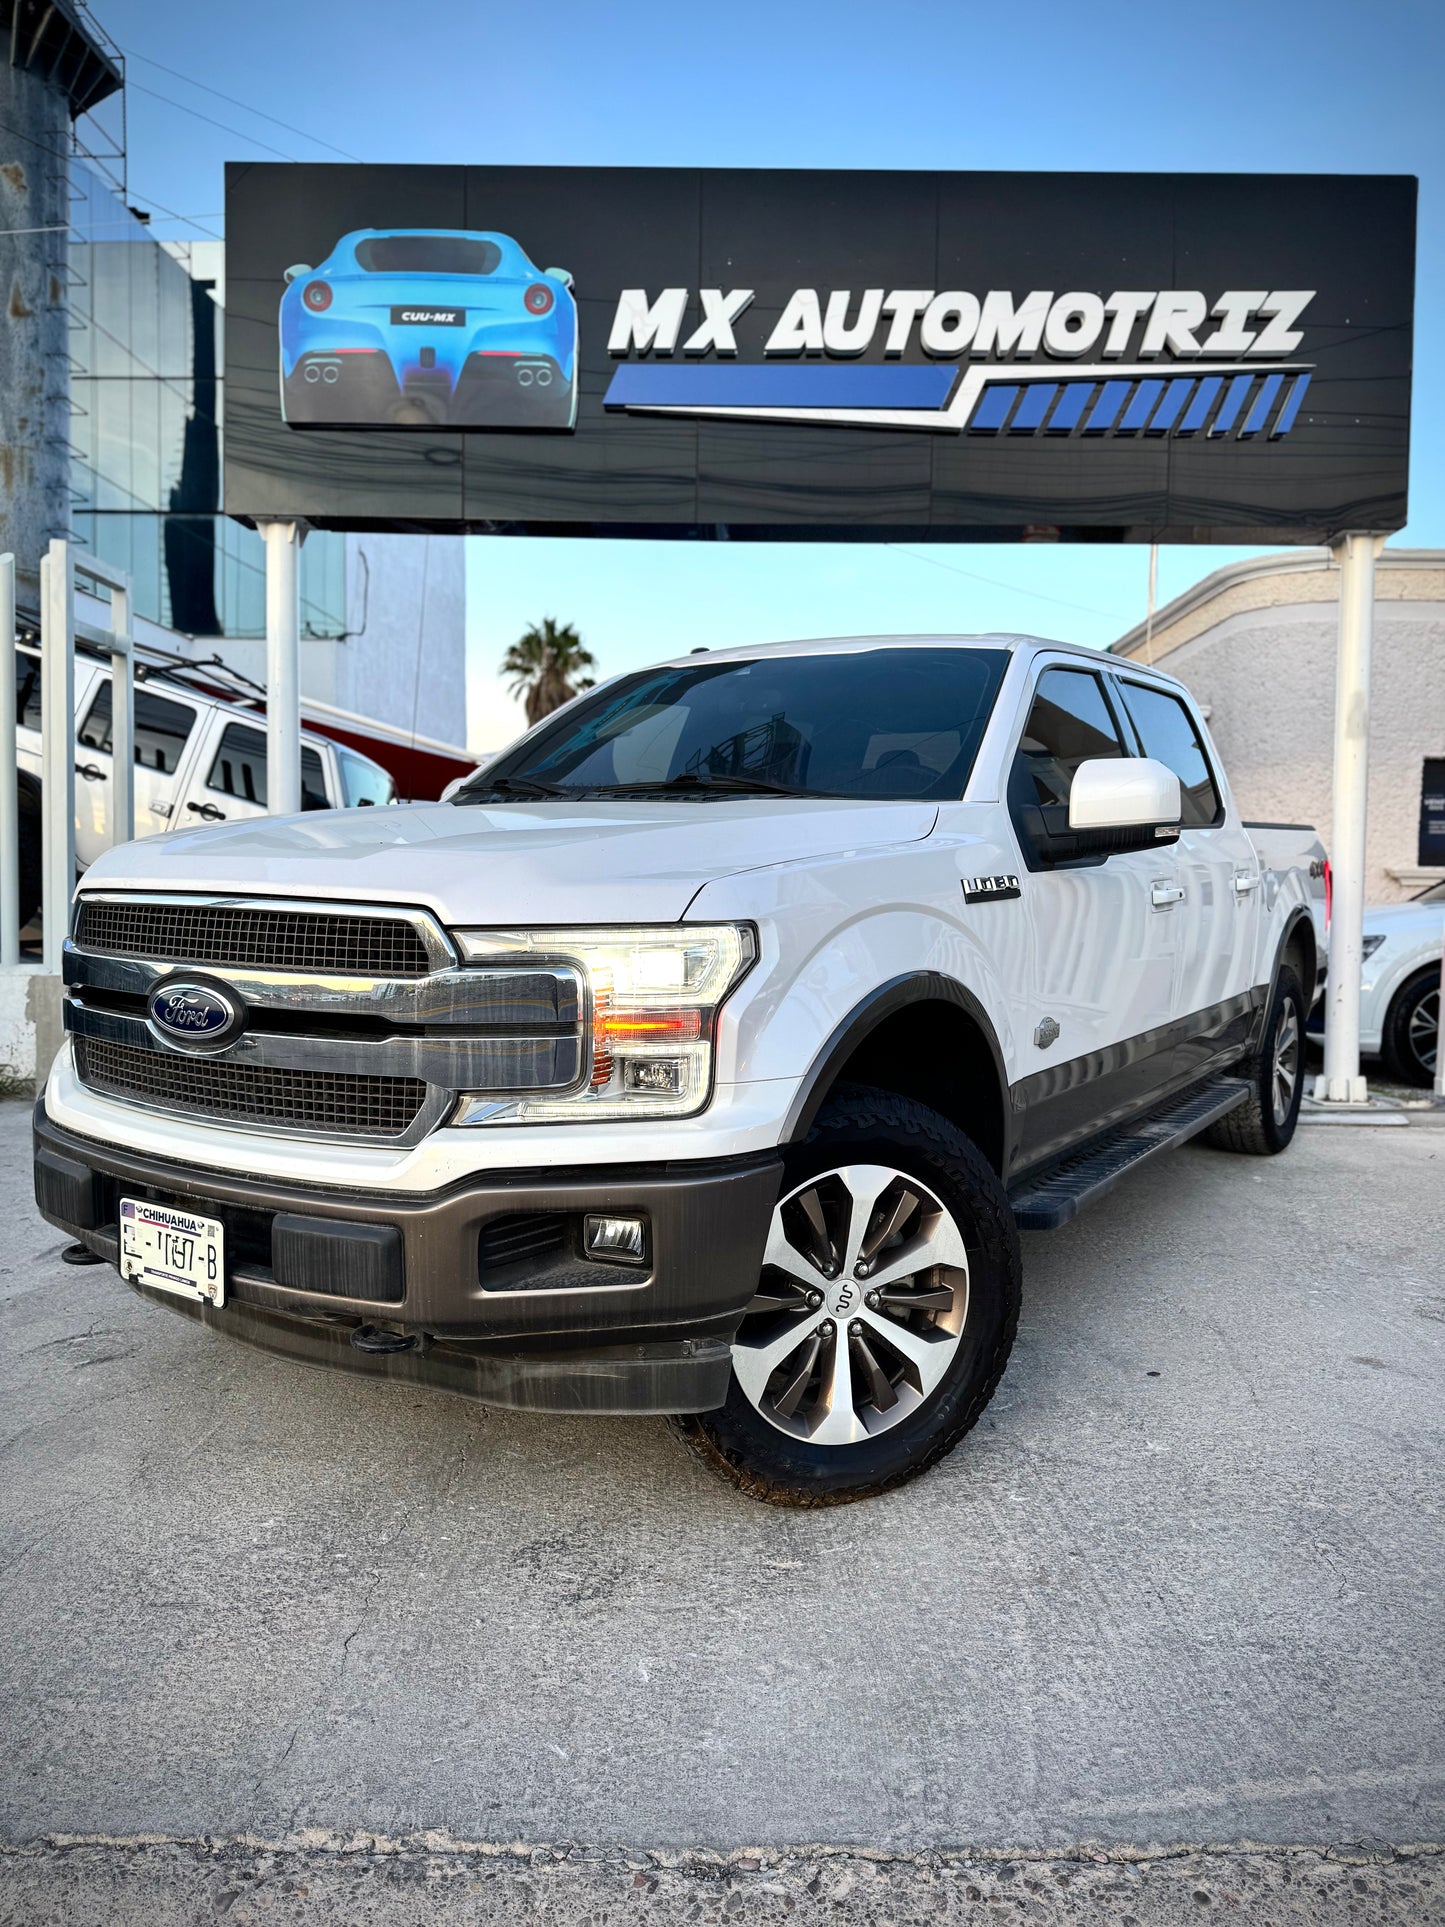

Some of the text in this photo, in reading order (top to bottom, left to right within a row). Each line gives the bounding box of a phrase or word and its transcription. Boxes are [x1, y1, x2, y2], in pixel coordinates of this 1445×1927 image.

[606, 289, 1317, 358] MX AUTOMOTRIZ
[164, 995, 210, 1028] Ford
[142, 1208, 197, 1231] CHIHUAHUA
